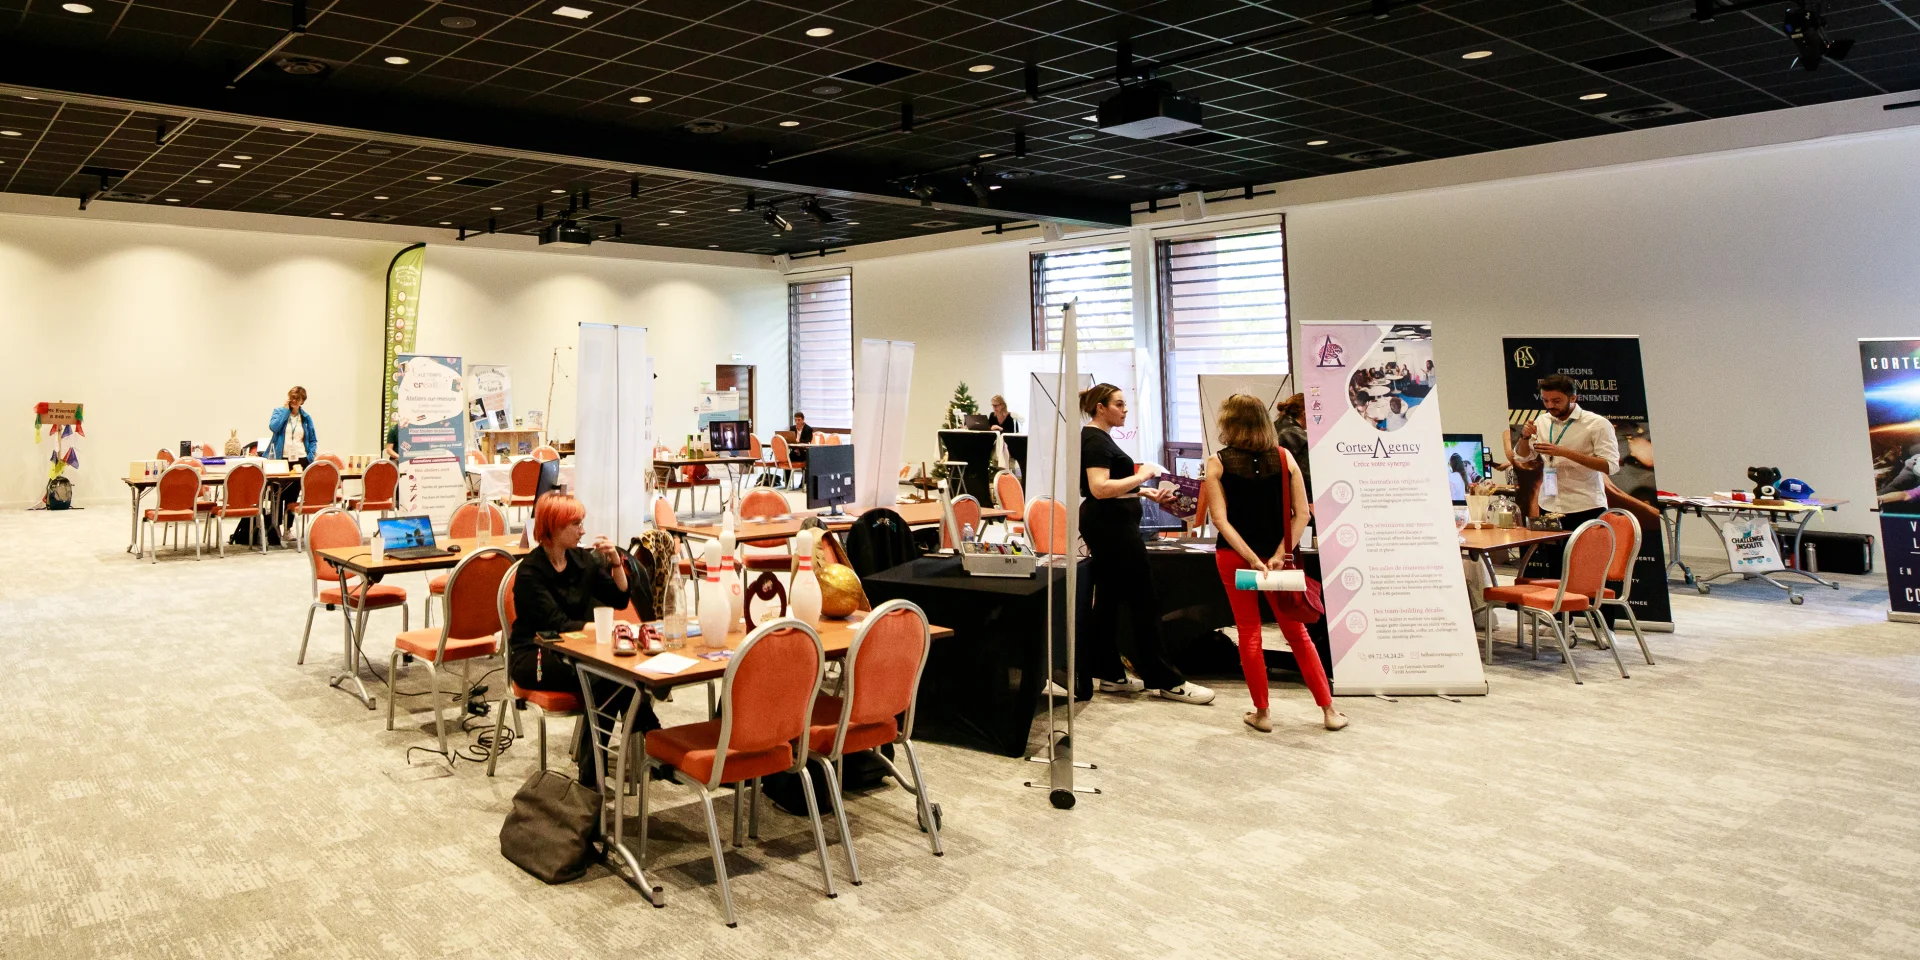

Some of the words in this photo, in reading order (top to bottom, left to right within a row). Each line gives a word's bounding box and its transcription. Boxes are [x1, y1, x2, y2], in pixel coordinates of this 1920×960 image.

[1557, 367, 1594, 375] CRÉONS
[1537, 379, 1618, 390] MBLE
[1731, 535, 1765, 544] CHALLENGE
[1736, 541, 1764, 550] INSOLITE
